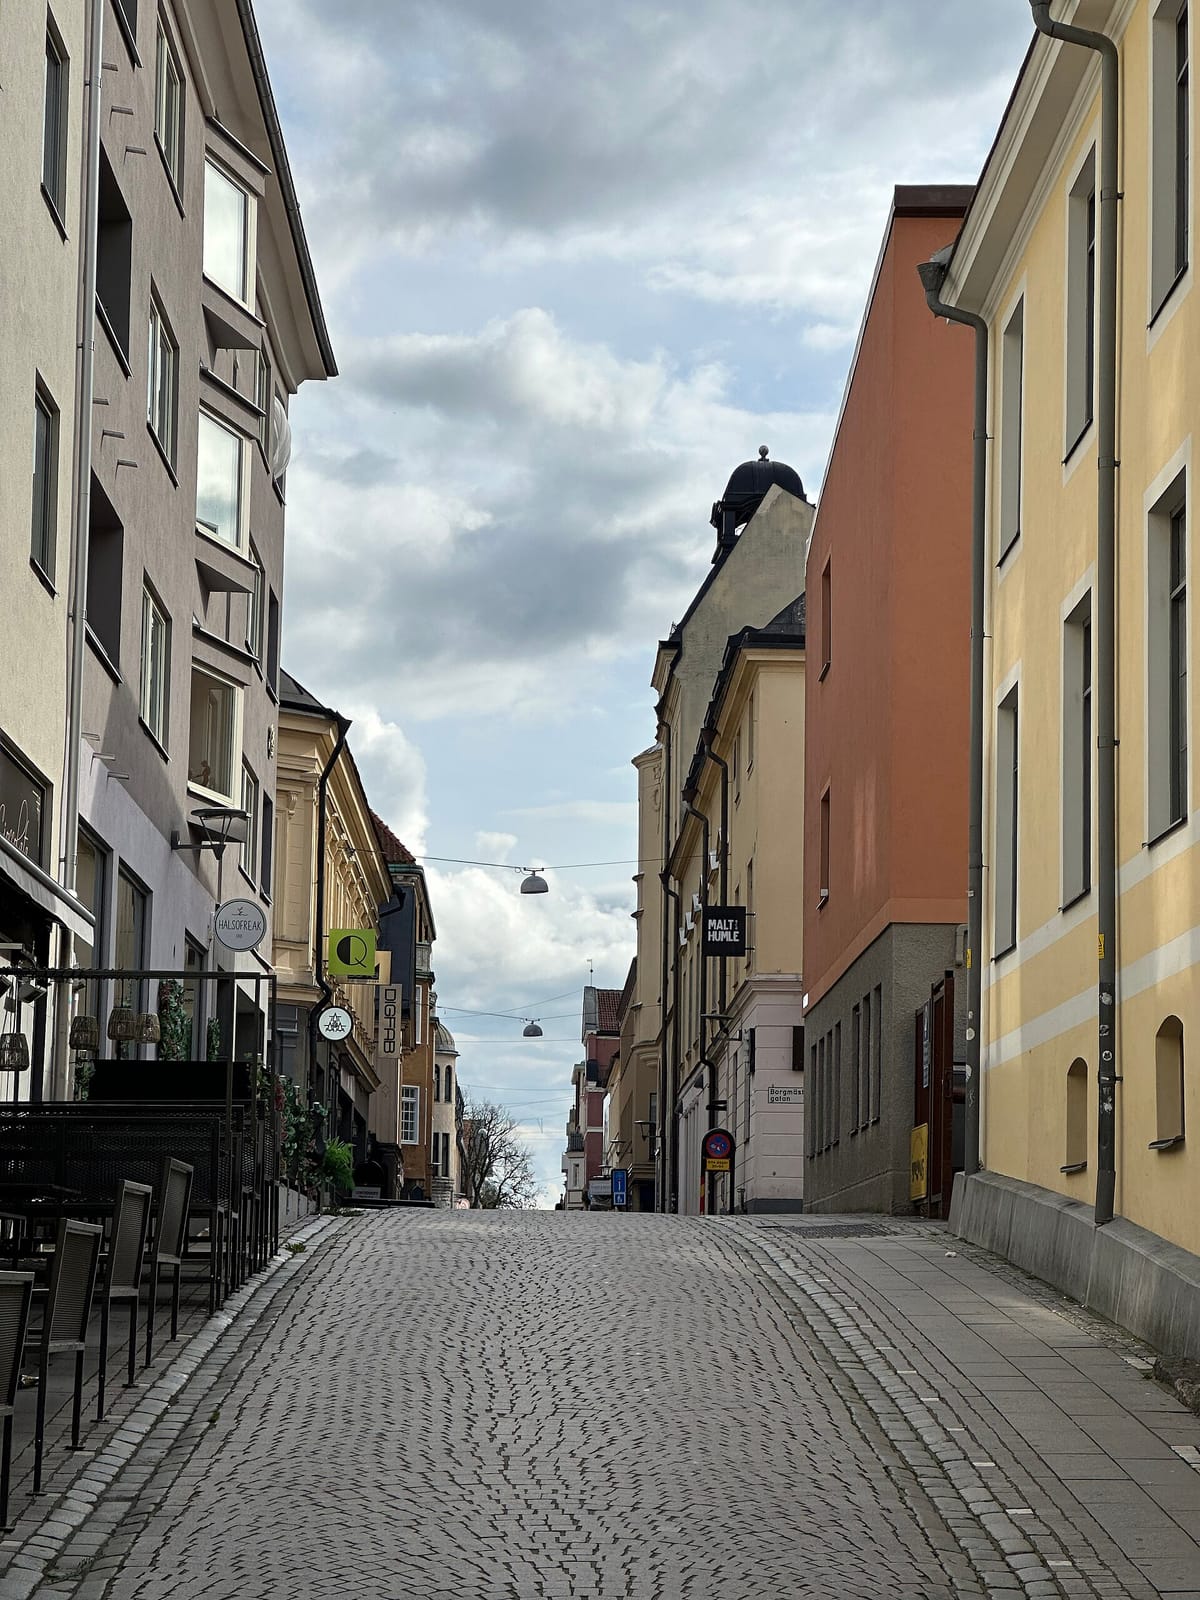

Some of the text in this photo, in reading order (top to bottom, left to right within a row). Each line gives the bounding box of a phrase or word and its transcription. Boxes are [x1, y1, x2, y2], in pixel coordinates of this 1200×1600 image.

[708, 919, 734, 930] MALT
[708, 930, 740, 942] HUMLE
[383, 988, 397, 1054] DIGFAB
